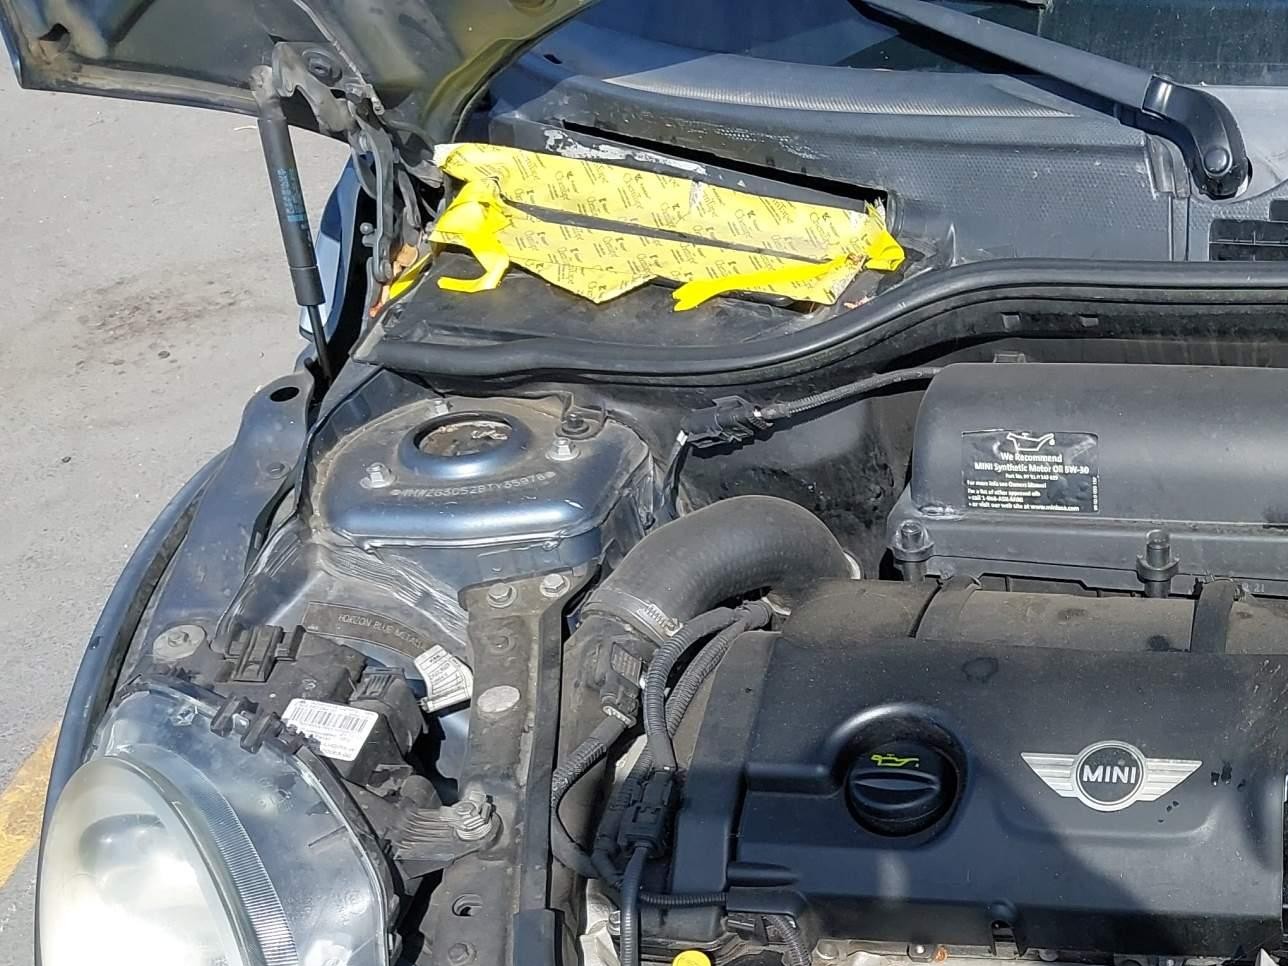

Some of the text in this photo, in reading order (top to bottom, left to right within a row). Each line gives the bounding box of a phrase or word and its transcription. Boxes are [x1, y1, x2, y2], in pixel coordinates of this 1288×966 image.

[1000, 452, 1062, 462] We Recommend
[974, 462, 1090, 474] MINI Synthetic Motor Oil 5W-30
[1083, 765, 1136, 783] MINI
